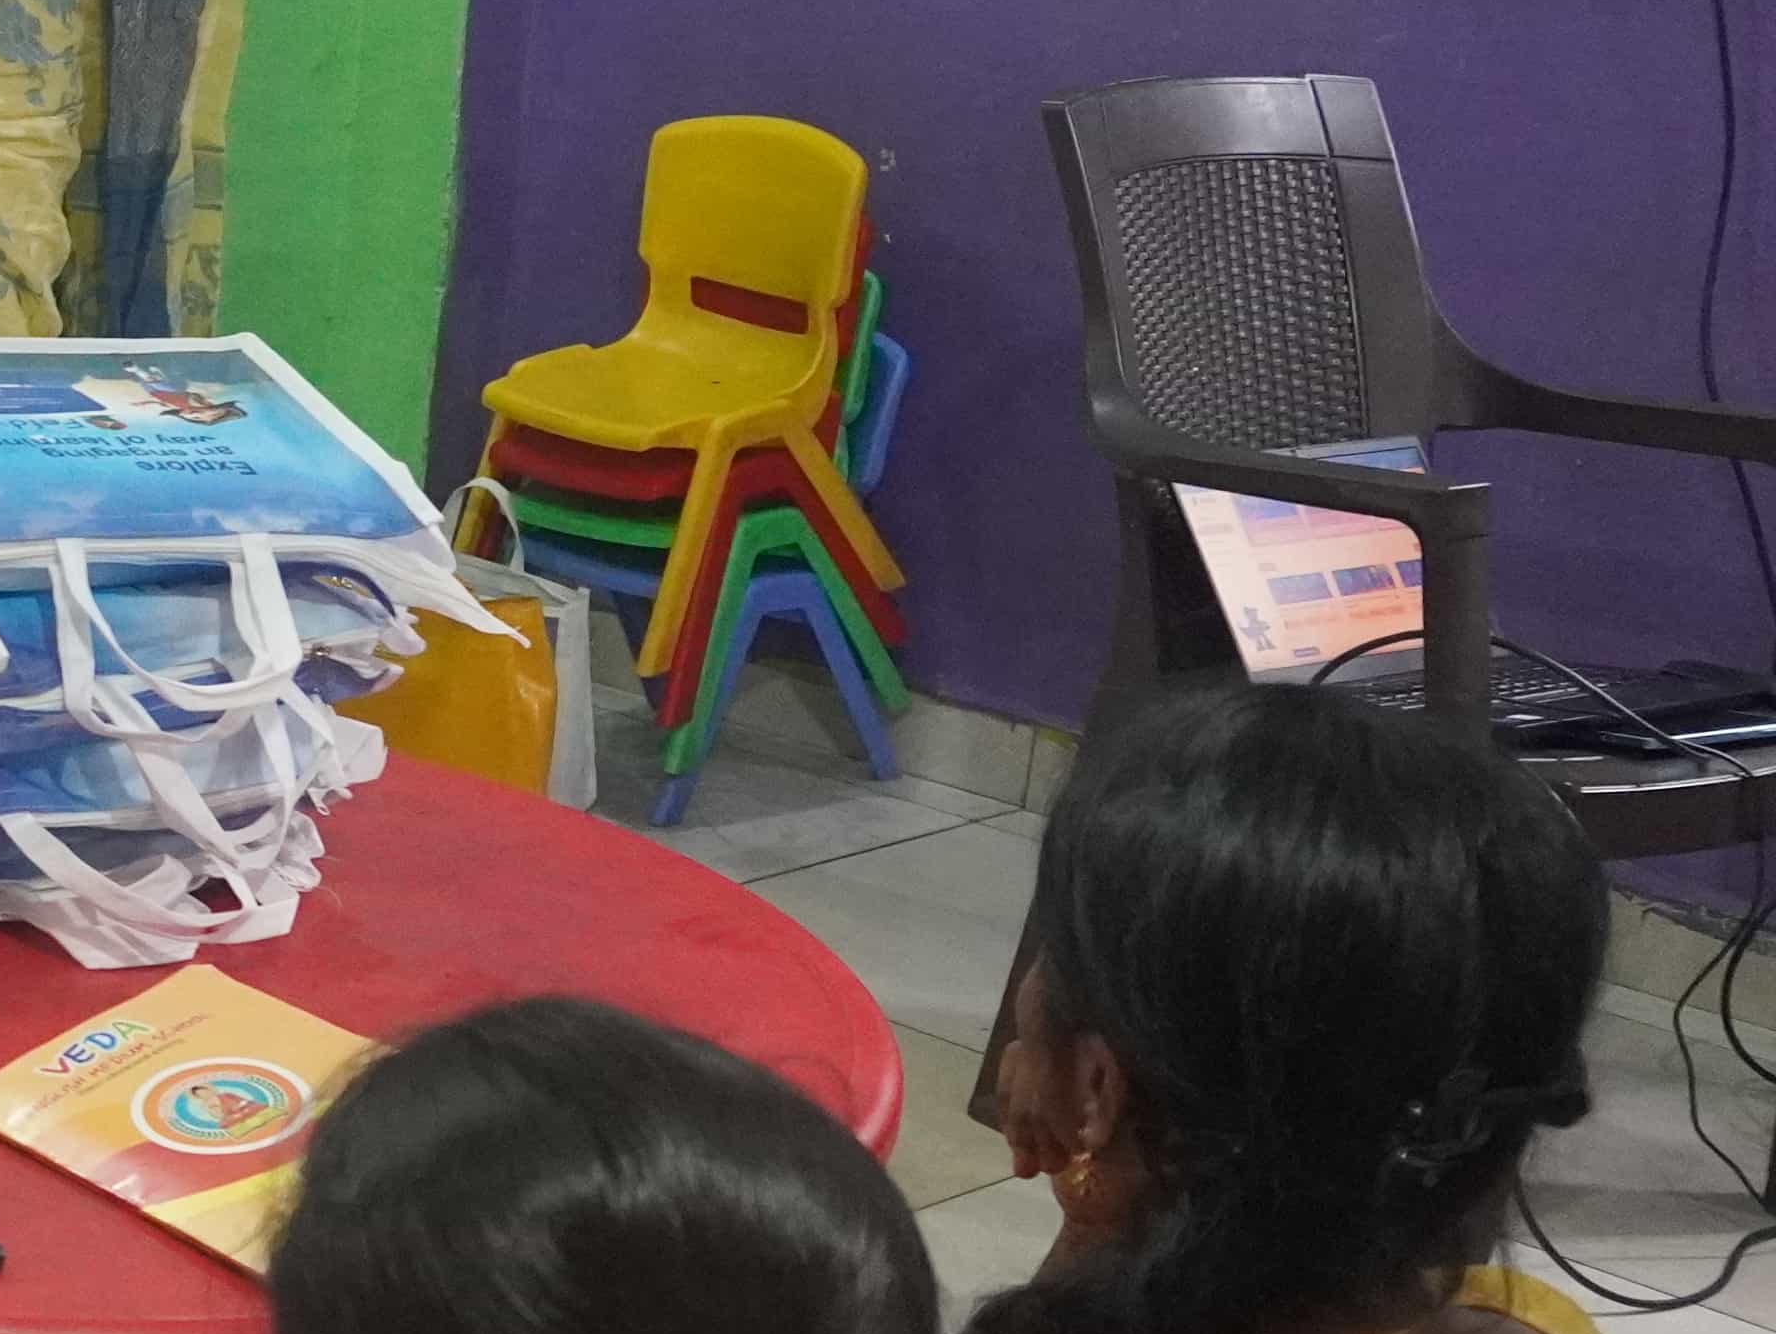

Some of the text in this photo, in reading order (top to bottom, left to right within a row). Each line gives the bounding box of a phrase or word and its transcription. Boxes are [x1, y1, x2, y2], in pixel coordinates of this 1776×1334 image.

[119, 435, 150, 447] of
[156, 433, 217, 446] way
[39, 445, 234, 459] an engaging
[134, 459, 259, 476] Explore
[39, 1019, 152, 1075] VEDA
